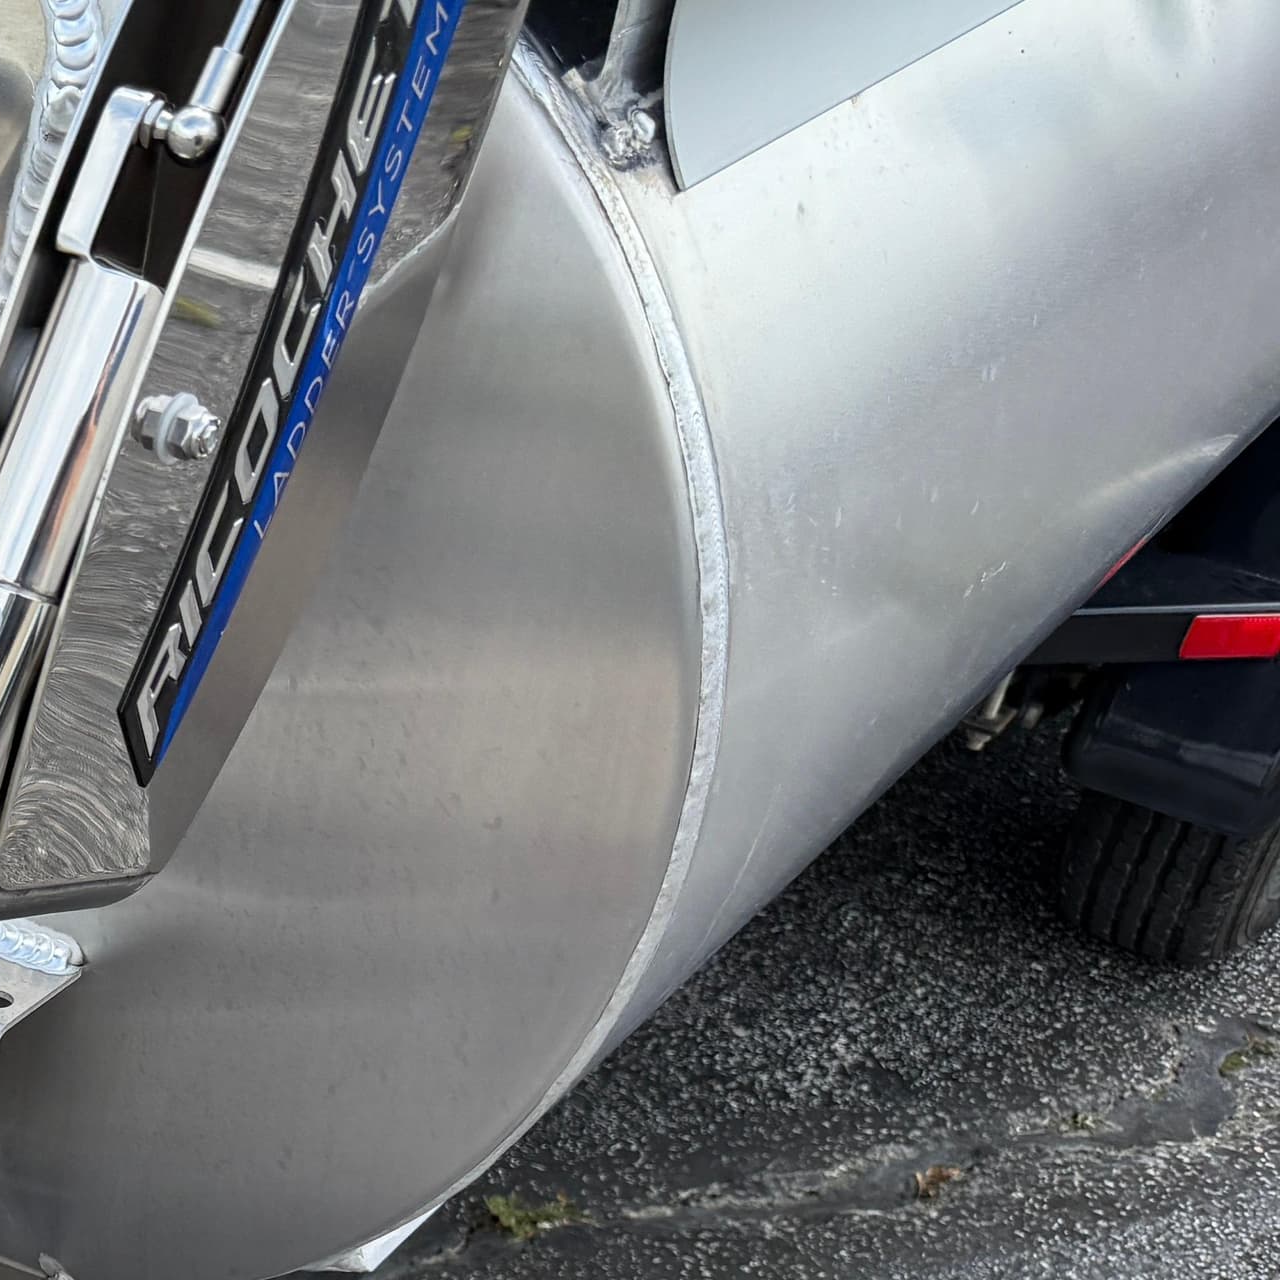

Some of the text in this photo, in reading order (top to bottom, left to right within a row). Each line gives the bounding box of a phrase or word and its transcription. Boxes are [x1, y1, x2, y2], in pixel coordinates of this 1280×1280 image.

[137, 0, 418, 761] RICOCHE
[253, 1, 449, 540] LADDER SYSTEM
